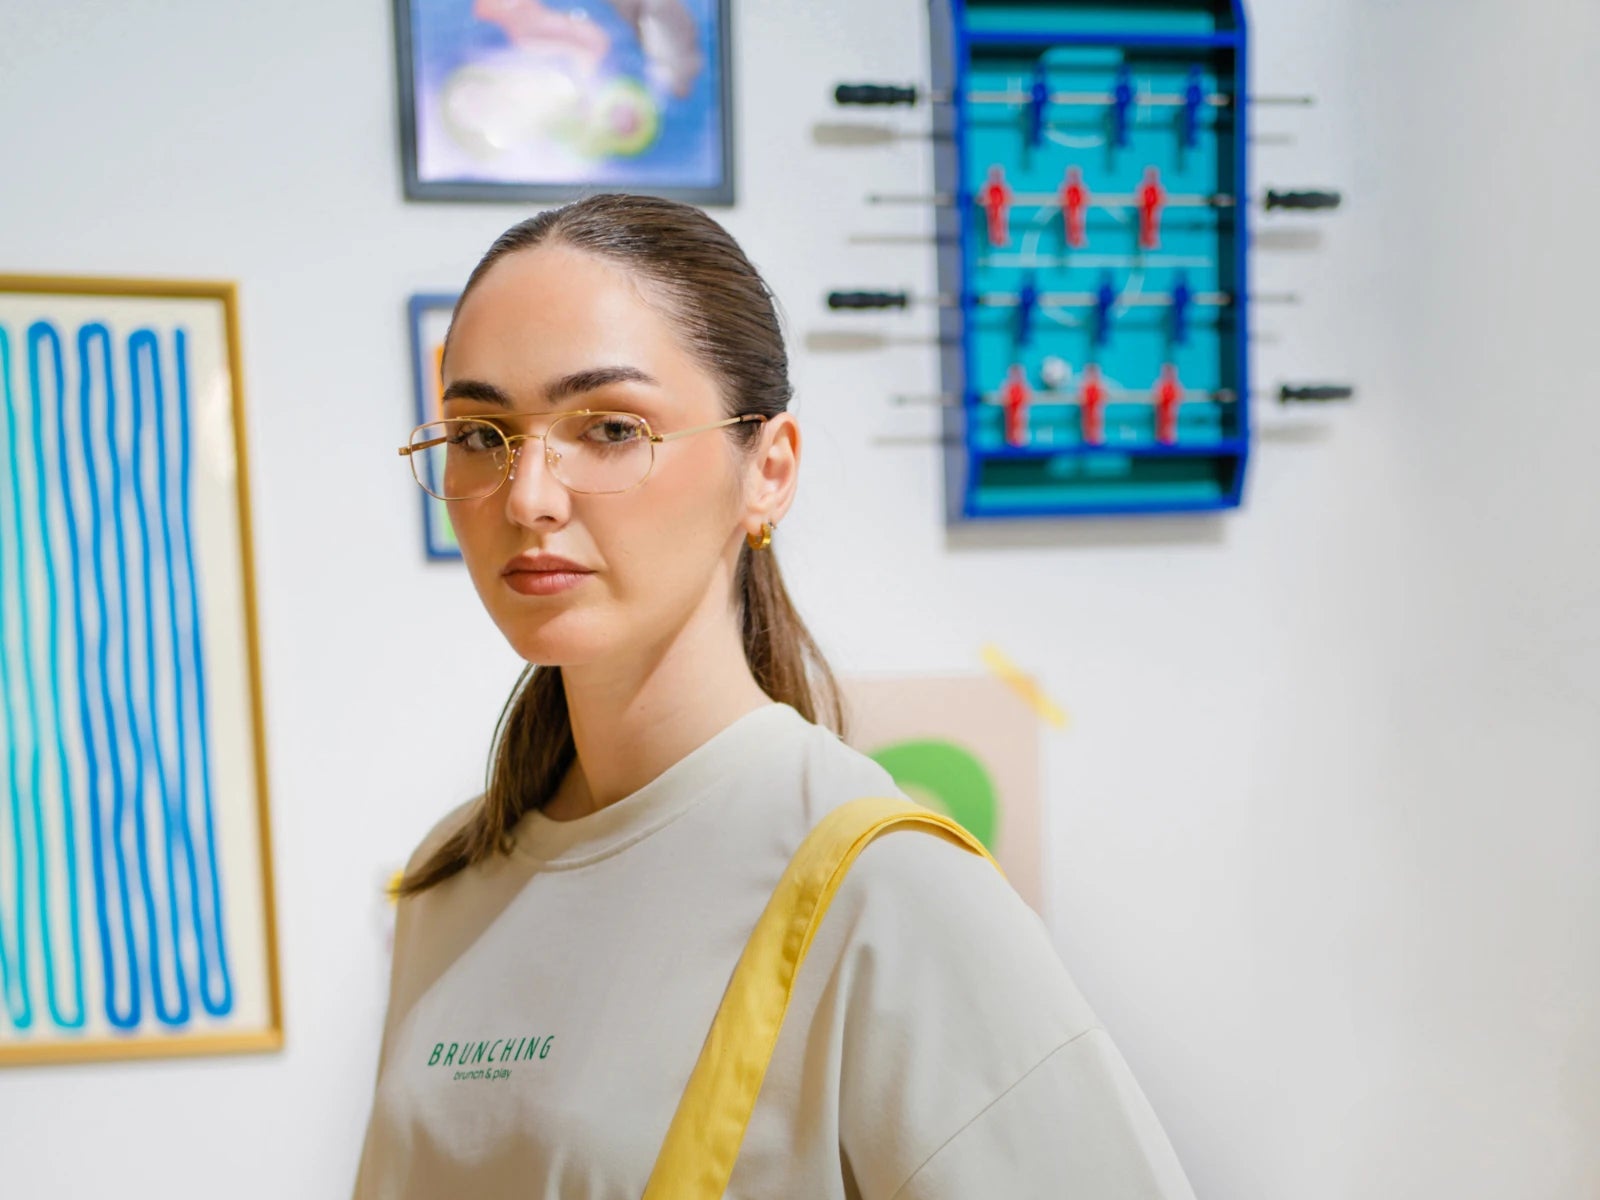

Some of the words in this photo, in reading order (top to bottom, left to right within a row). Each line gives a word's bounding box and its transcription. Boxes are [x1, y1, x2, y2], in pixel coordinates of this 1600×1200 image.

[427, 1035, 555, 1067] BRUNCHING
[453, 1068, 484, 1081] brunch
[485, 1068, 493, 1080] &
[492, 1068, 512, 1082] play
